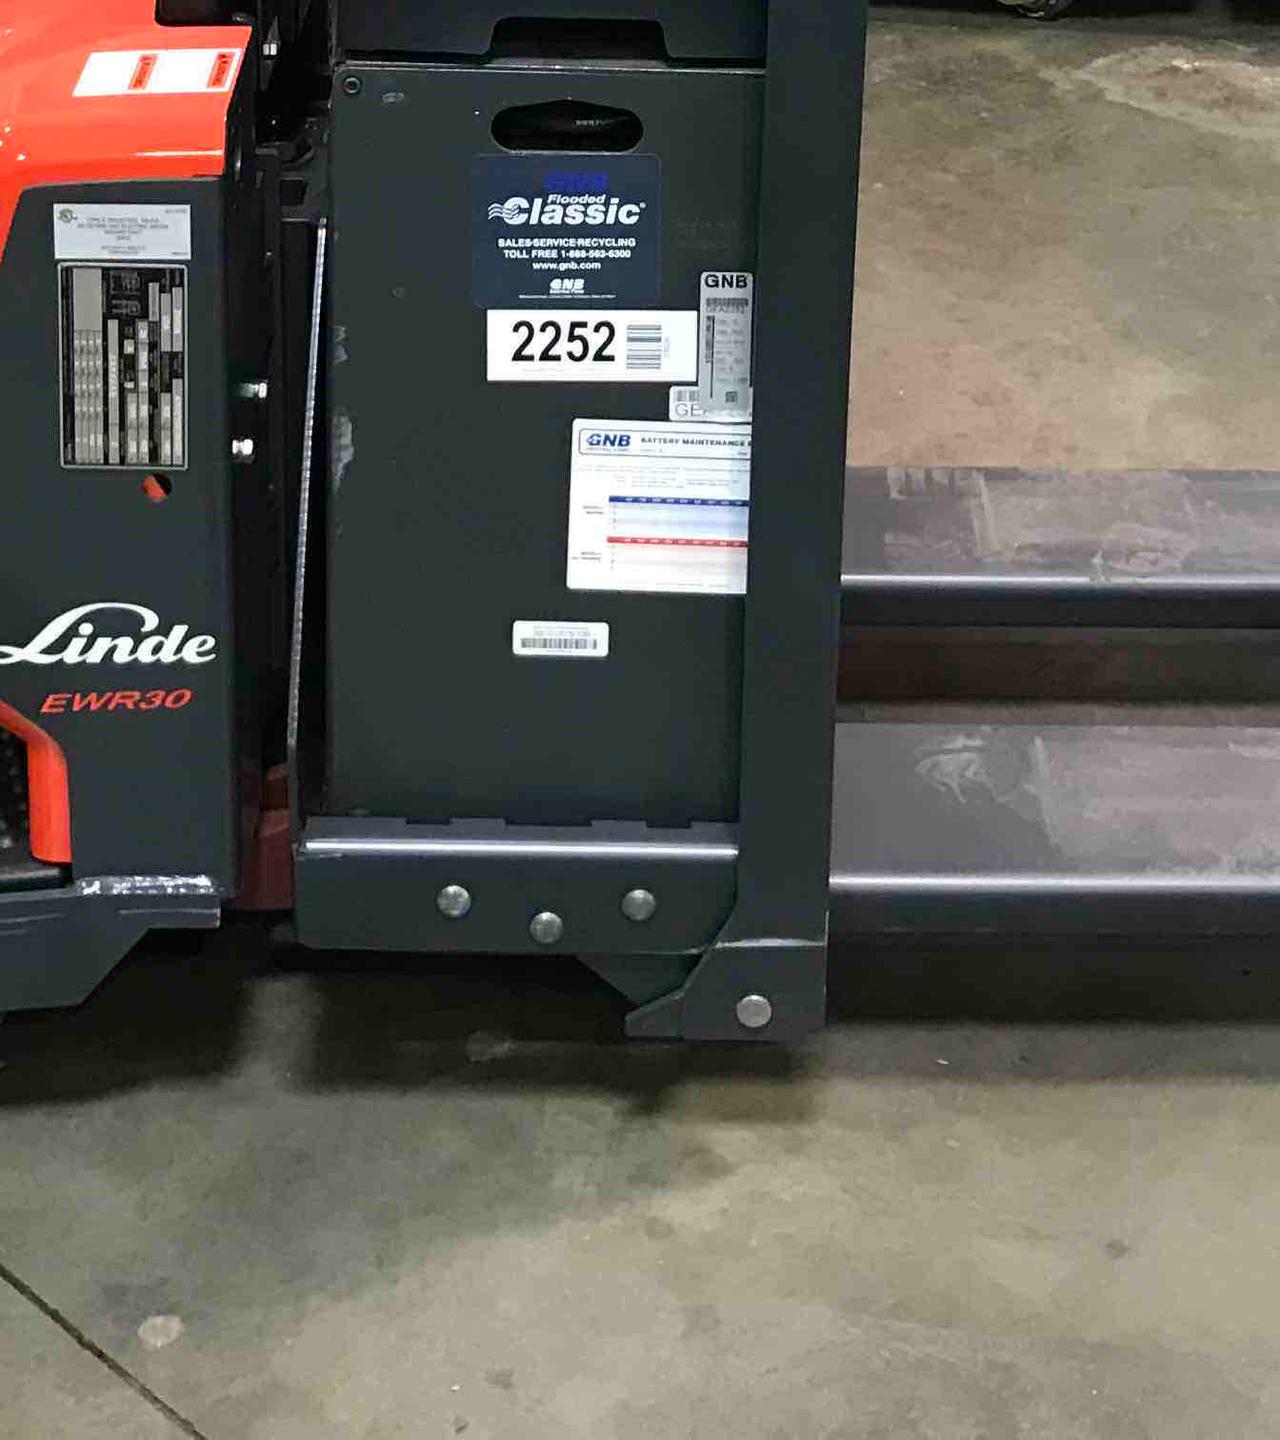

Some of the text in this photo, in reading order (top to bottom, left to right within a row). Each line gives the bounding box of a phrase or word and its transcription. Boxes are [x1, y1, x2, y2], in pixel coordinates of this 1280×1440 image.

[547, 193, 607, 205] Flooded
[502, 196, 642, 226] Classic
[503, 249, 529, 259] TOLL
[531, 249, 558, 259] FREE
[532, 261, 602, 271] www.gnb.com
[704, 274, 748, 289] GNB
[511, 320, 616, 363] 2252
[586, 433, 631, 447] GNB
[40, 688, 193, 715] EWR30
